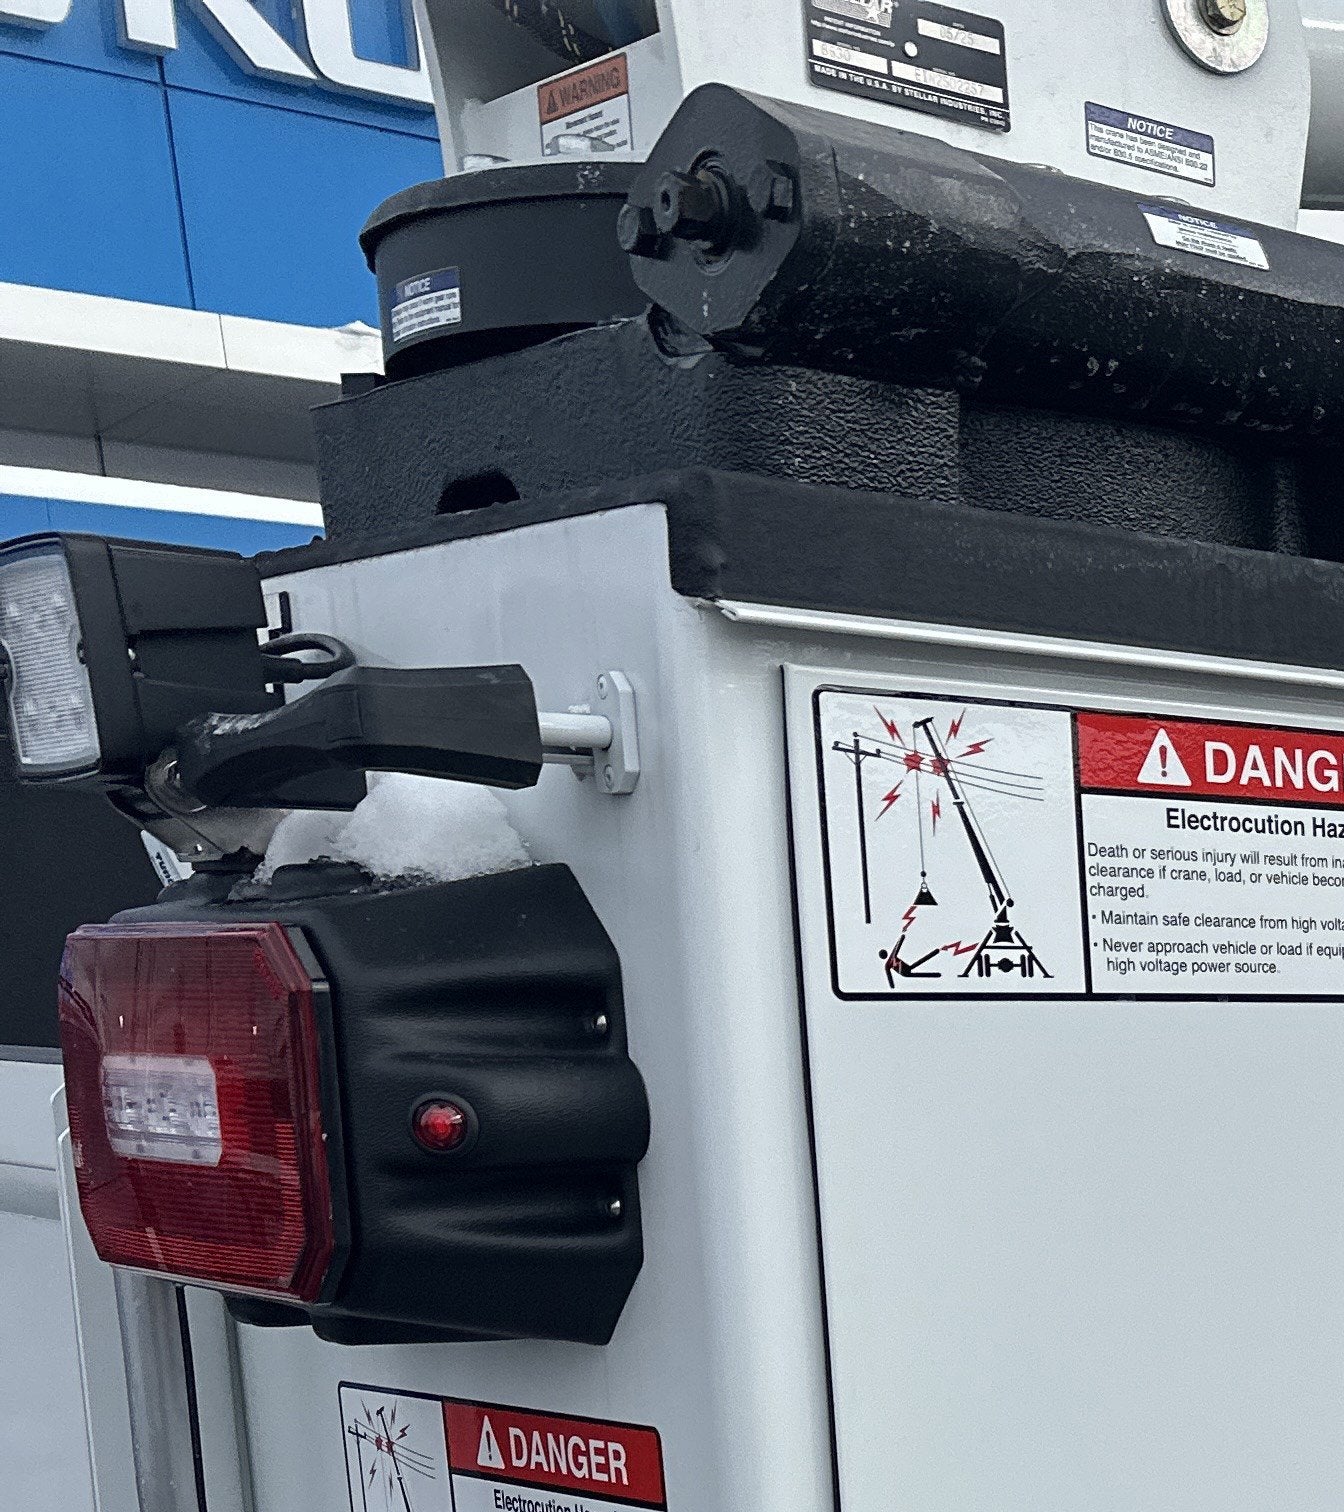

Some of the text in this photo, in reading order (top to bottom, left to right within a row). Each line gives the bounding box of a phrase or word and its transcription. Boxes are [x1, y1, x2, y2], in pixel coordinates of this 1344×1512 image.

[560, 67, 620, 107] WARNING
[814, 64, 837, 77] MADE
[838, 70, 848, 79] IN
[849, 73, 864, 84] THE
[866, 77, 890, 91] U.S.A.
[892, 84, 902, 94] BY
[904, 87, 939, 103] STELLAR
[1127, 118, 1173, 140] NOTICE
[1178, 214, 1217, 229] NOTICE
[1166, 808, 1305, 836] Electrocution
[1088, 843, 1128, 858] Death
[1133, 848, 1146, 859] or
[1150, 847, 1198, 862] serious
[1202, 849, 1236, 867] injury
[1240, 851, 1260, 864] will
[1263, 853, 1298, 866] result
[1301, 854, 1328, 868] from
[1088, 863, 1155, 879] clearance
[1159, 866, 1166, 879] if
[1170, 869, 1211, 883] crane,
[1215, 869, 1246, 885] load,
[1250, 872, 1263, 883] or
[1266, 871, 1308, 886] vehicle
[1089, 883, 1149, 900] charged.
[1101, 910, 1158, 926] Maintain
[1162, 913, 1190, 926] safe
[1194, 913, 1256, 928] clearance
[1260, 915, 1287, 929] from
[1292, 916, 1317, 933] high
[1103, 938, 1143, 952] Never
[1147, 940, 1209, 956] approach
[1212, 941, 1257, 955] vehicle
[1260, 944, 1273, 955] or
[1277, 942, 1302, 956] load
[1306, 942, 1313, 956] if
[1106, 957, 1281, 975] high voltage power source.
[508, 1427, 629, 1485] DANGER
